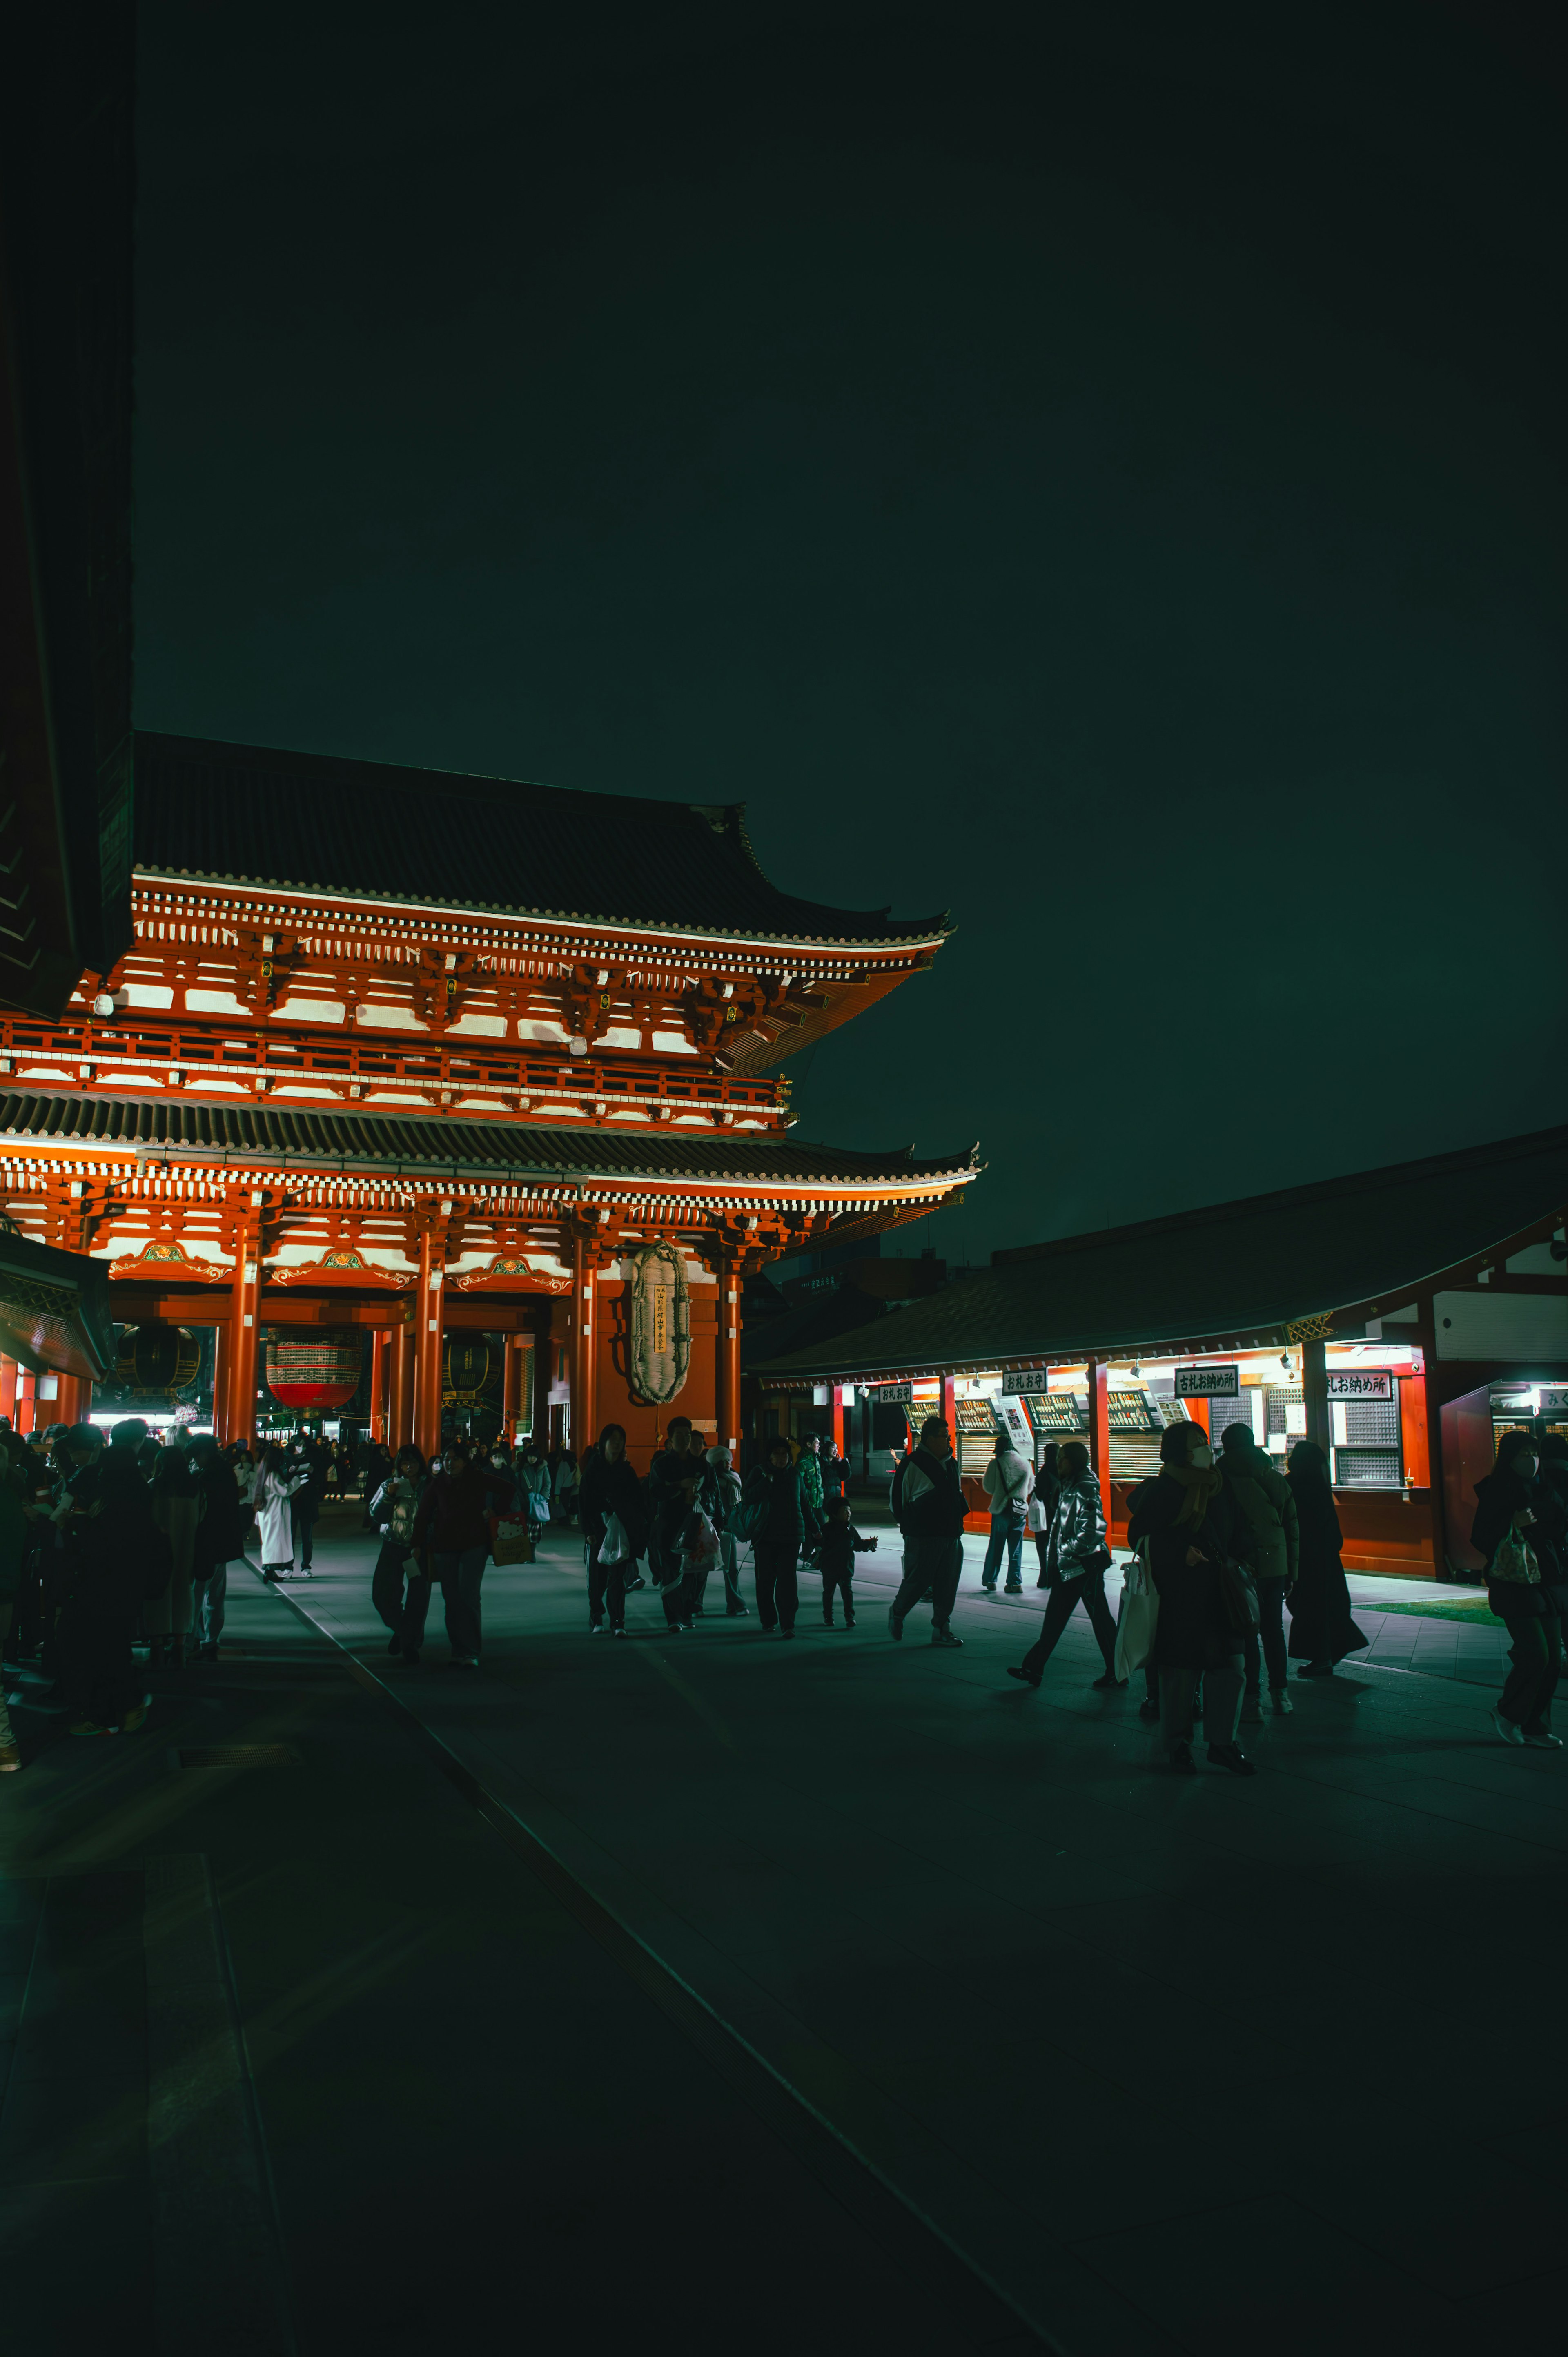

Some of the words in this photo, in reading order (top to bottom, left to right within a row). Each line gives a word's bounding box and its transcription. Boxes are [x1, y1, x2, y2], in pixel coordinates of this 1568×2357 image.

[1008, 1373, 1042, 1390] お札お守
[1180, 1372, 1234, 1391] 古札お納め所
[883, 1386, 909, 1401] お札お守
